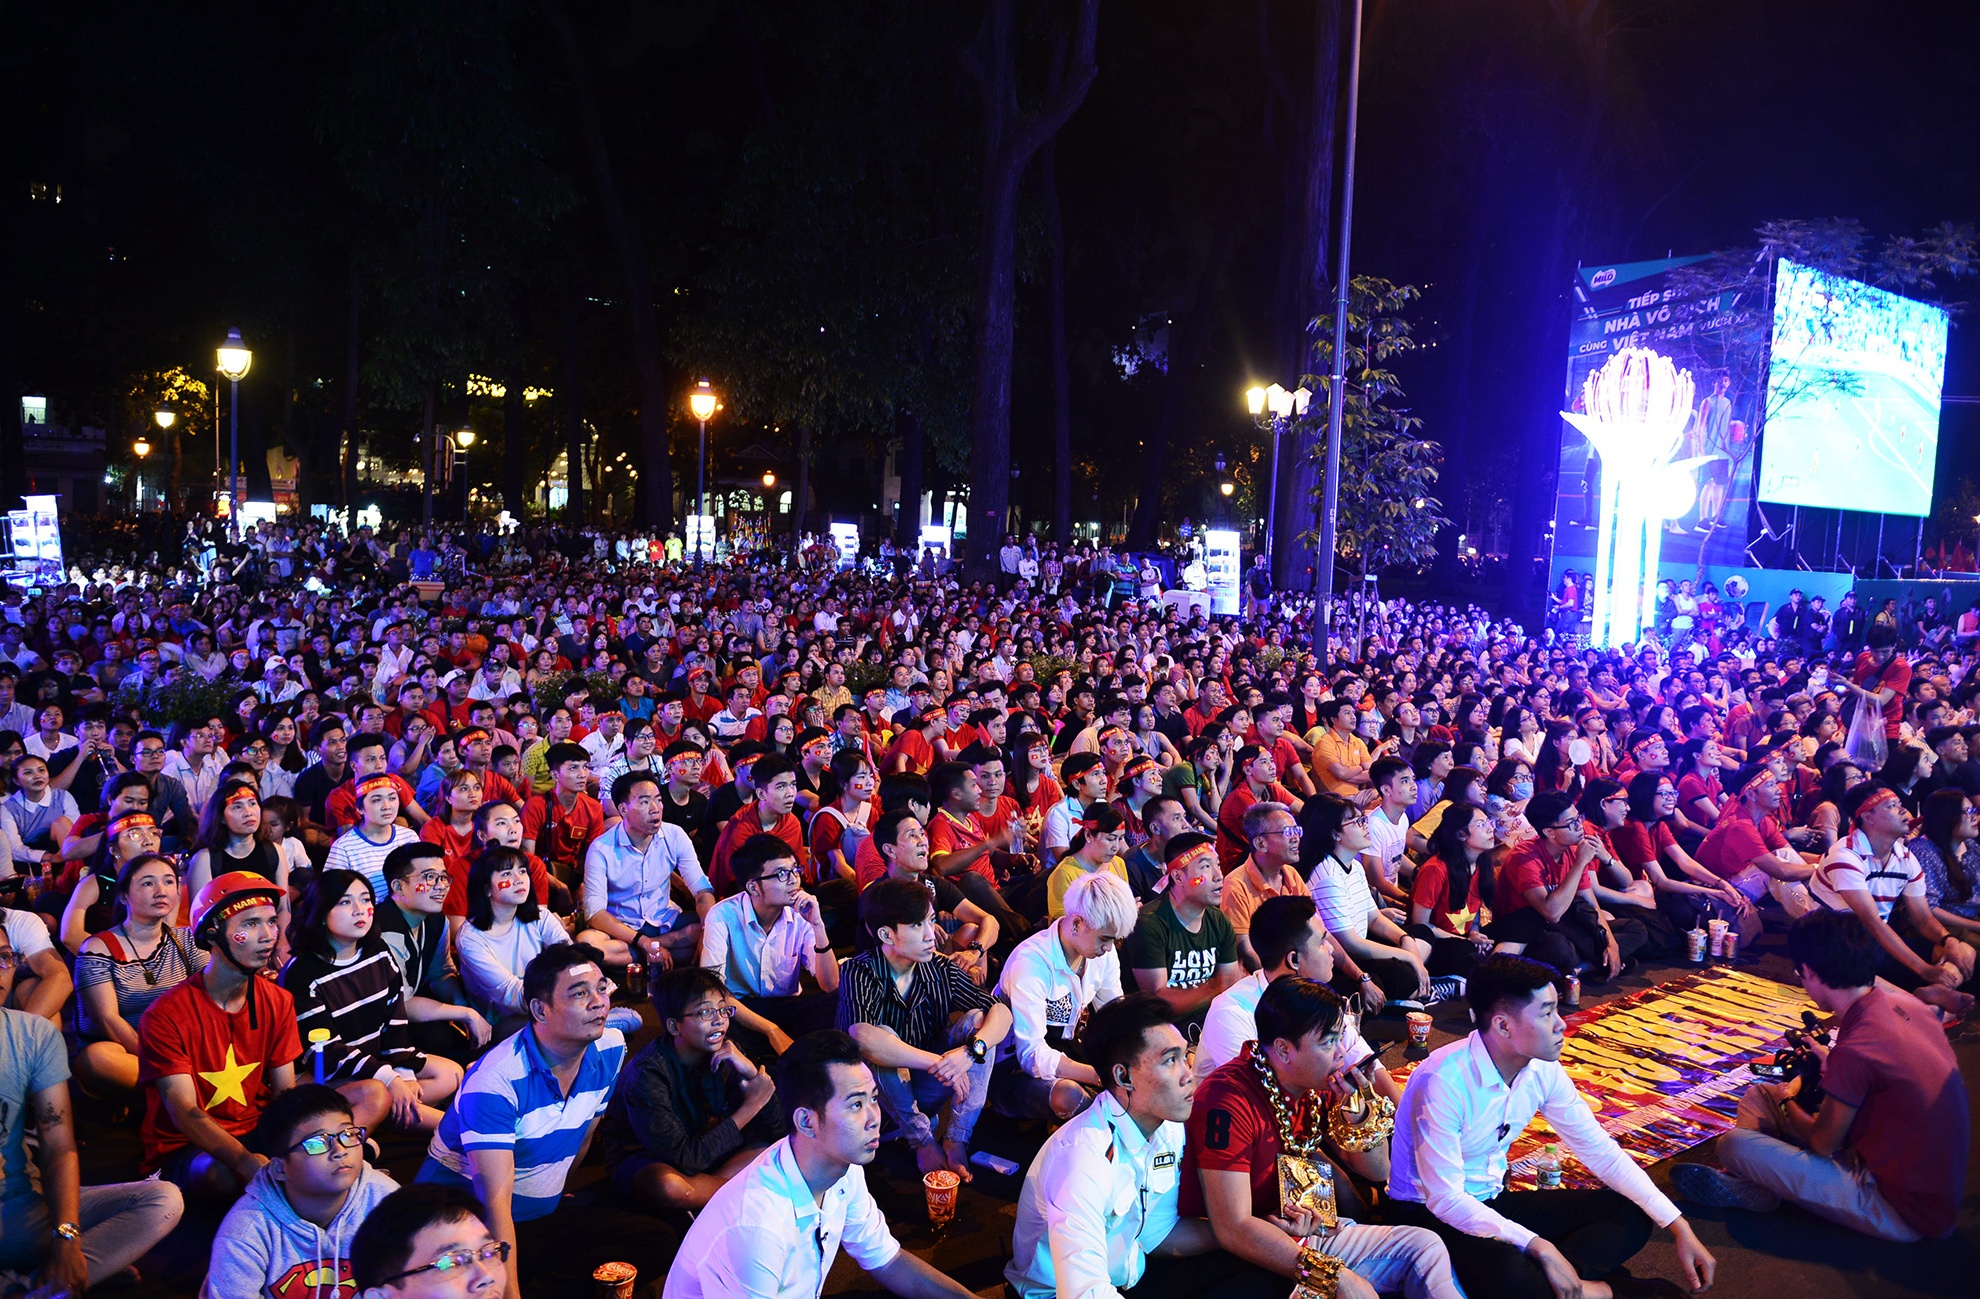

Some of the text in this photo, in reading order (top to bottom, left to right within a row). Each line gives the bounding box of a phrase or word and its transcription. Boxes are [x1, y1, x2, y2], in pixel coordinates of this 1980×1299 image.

[1593, 273, 1614, 284] MILO
[1628, 290, 1660, 310] TIẾP
[1604, 311, 1641, 335] NHÀ
[1646, 304, 1672, 325] VÔ
[233, 897, 258, 912] NAM
[1172, 947, 1217, 969] LON
[1206, 1108, 1232, 1150] 8
